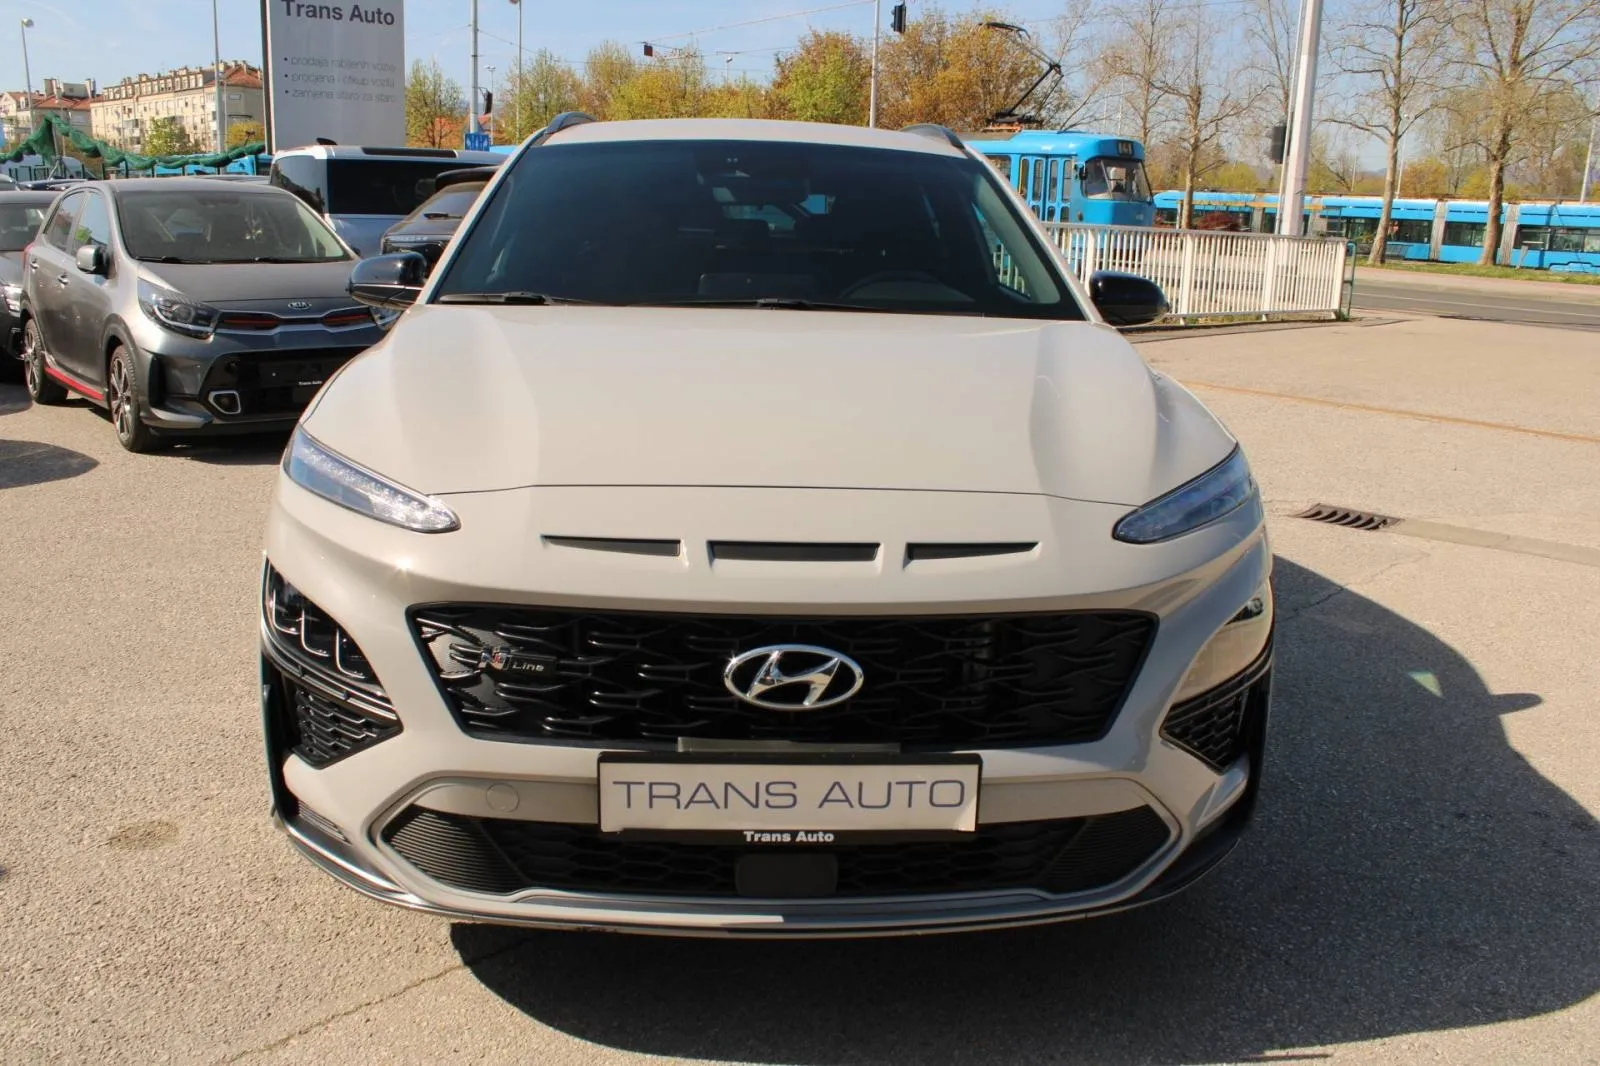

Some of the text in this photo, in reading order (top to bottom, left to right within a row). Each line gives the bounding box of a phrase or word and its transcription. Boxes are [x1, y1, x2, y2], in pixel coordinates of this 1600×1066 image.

[282, 0, 395, 26] Trans Auto
[512, 662, 545, 672] Line
[612, 779, 966, 810] TRANS AUTO
[743, 831, 835, 842] Trans Auto
